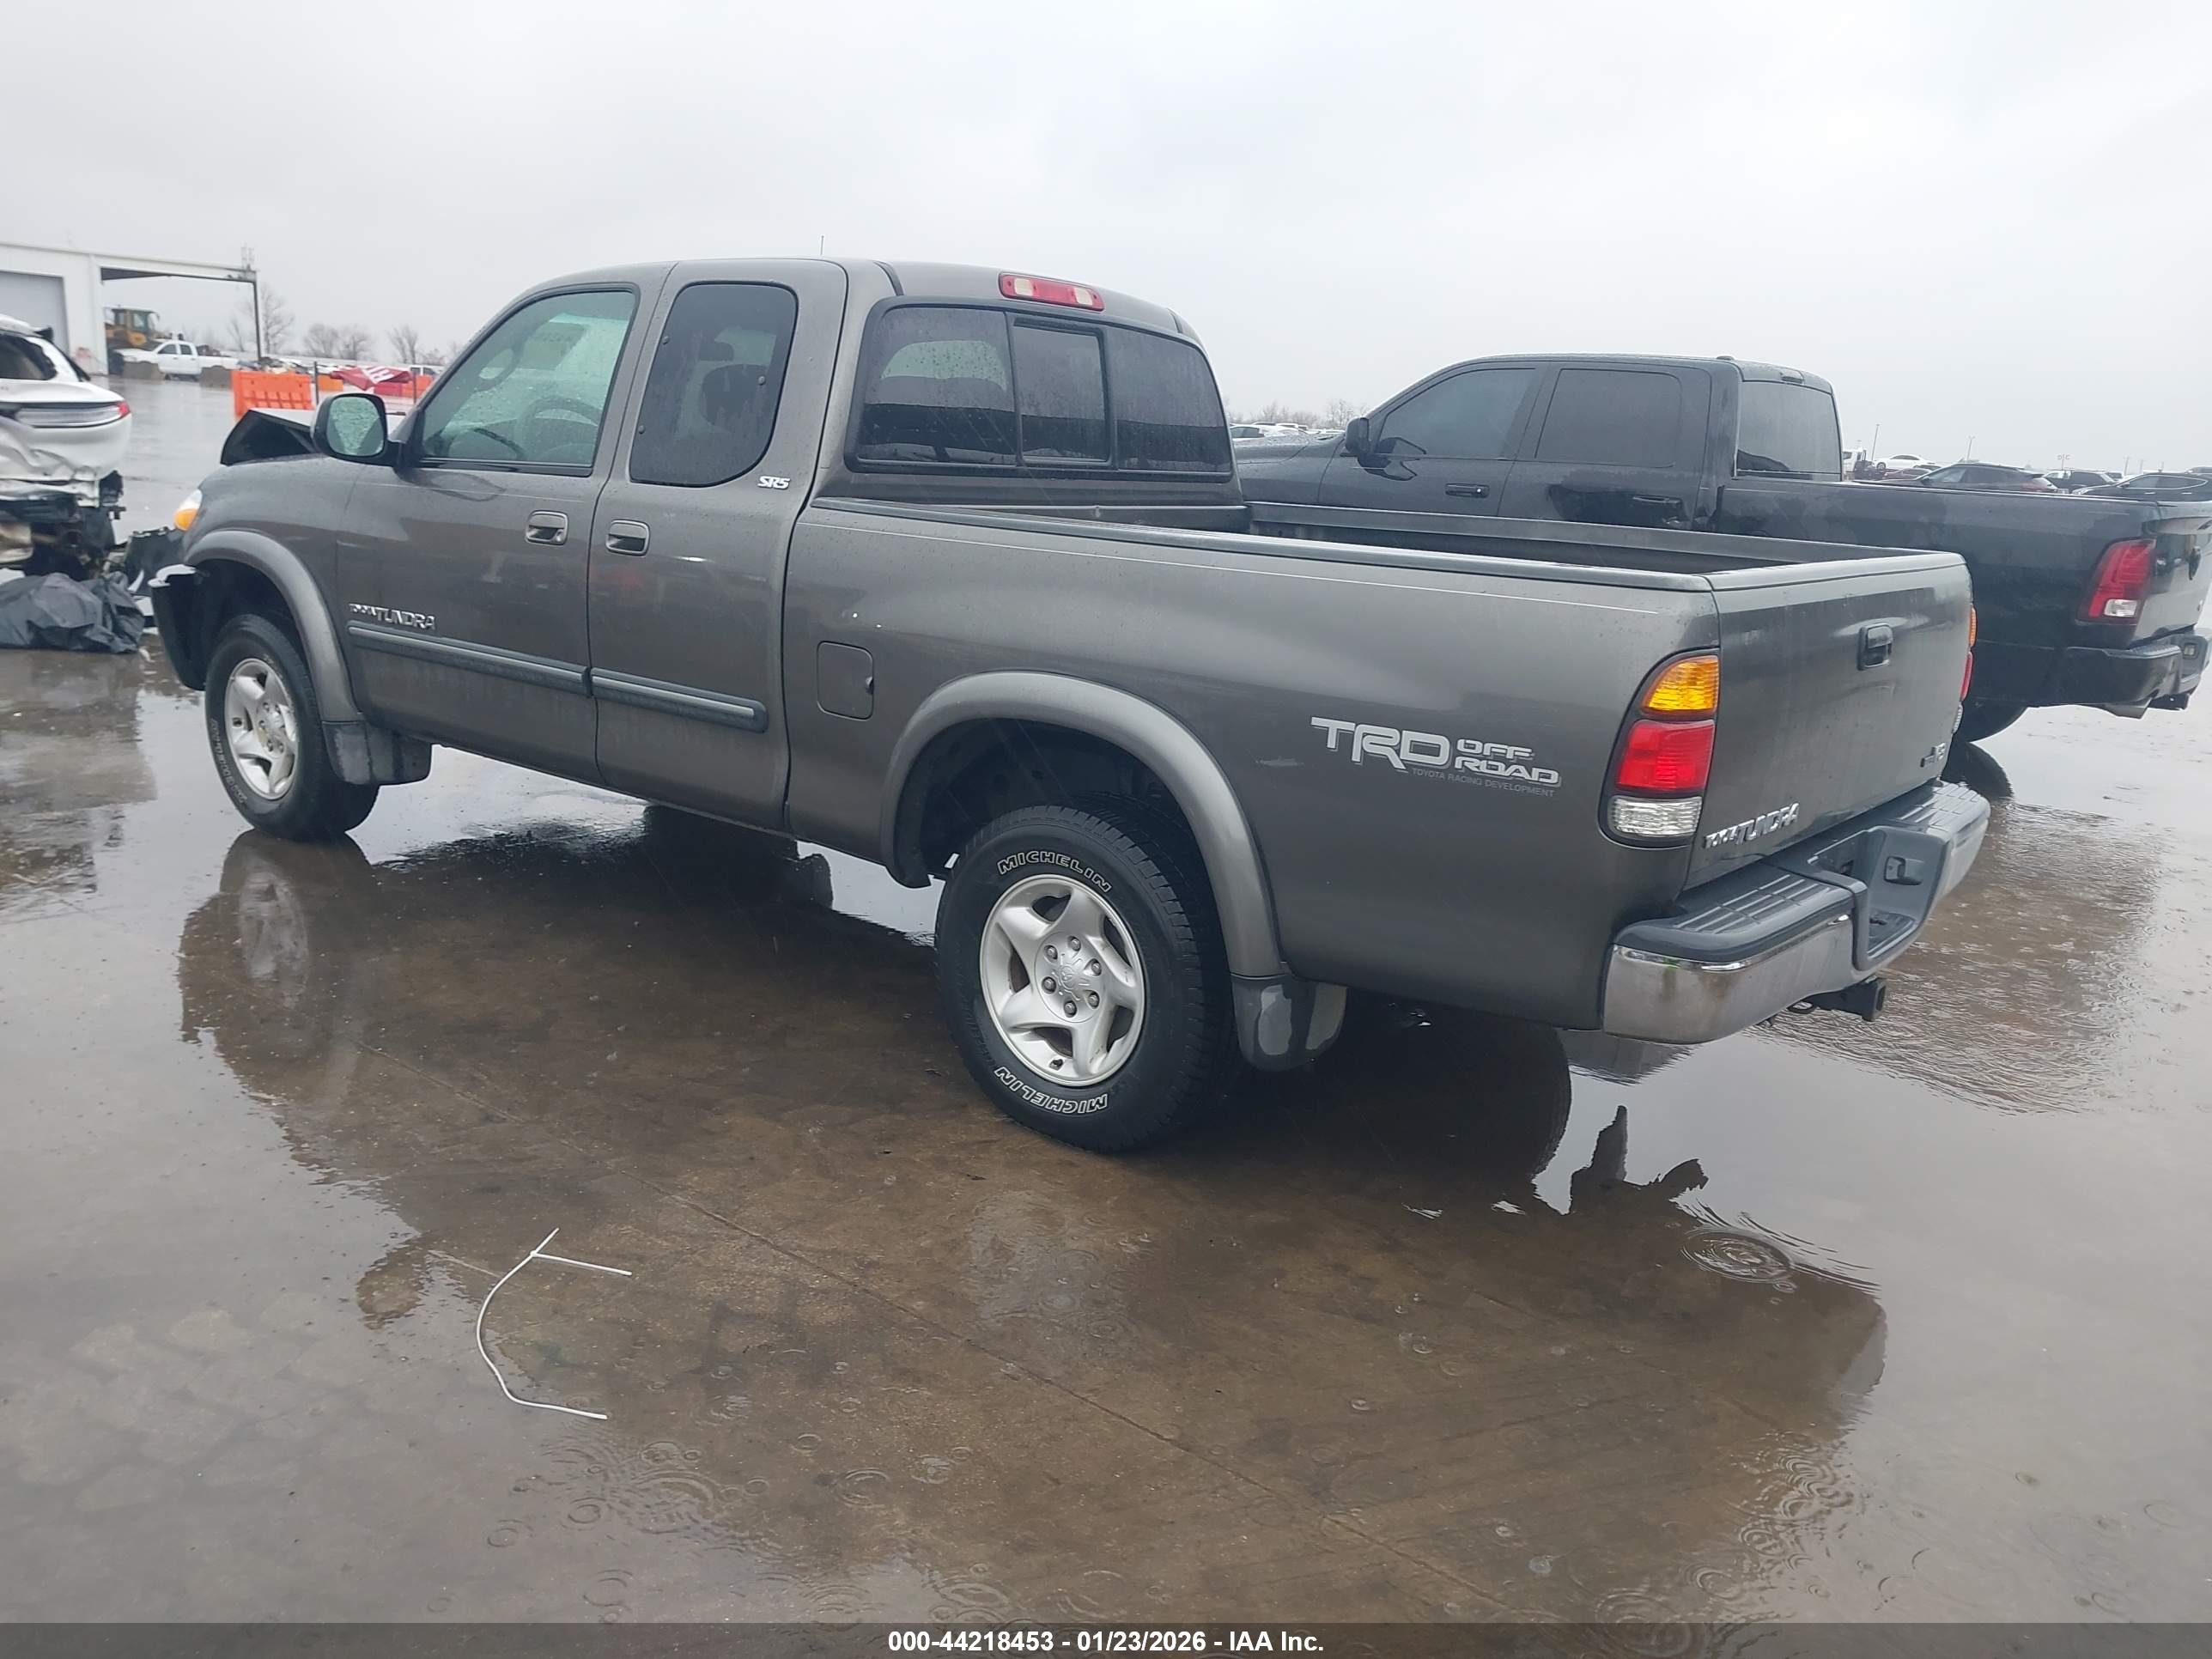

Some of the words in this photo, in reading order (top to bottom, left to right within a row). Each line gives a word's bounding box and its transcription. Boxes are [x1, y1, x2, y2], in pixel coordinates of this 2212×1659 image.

[757, 476, 791, 490] SR5
[375, 606, 435, 630] TUNDRA
[1310, 716, 1451, 773] TRD
[1456, 738, 1535, 762] OFF
[1412, 768, 1445, 779] TOYOTA
[1447, 773, 1482, 786] RACING
[1484, 779, 1555, 798] DEVELOPMENT
[1454, 756, 1561, 787] ROAD
[996, 850, 1112, 893] MICHELIN
[994, 1066, 1109, 1114] MICHELIN
